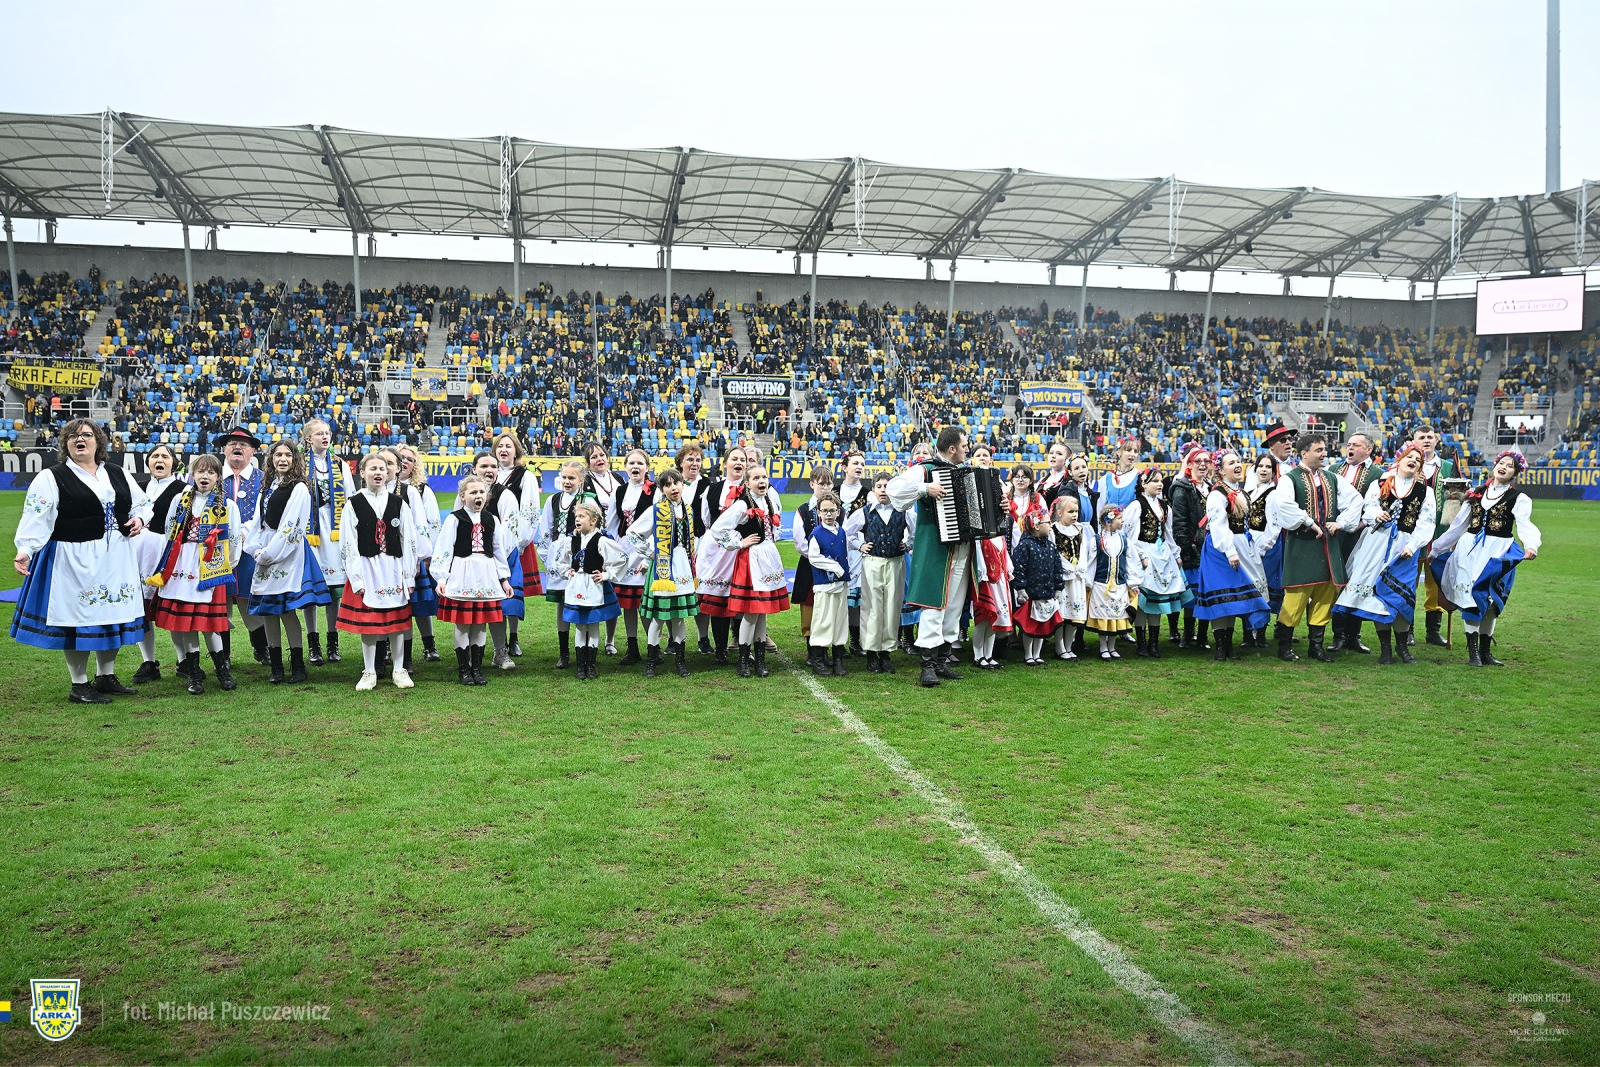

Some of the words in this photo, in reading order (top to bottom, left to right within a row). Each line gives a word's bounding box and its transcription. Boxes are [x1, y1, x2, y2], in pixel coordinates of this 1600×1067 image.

[33, 359, 44, 367] PO
[72, 372, 96, 386] HEL
[33, 384, 44, 393] PO
[393, 381, 401, 390] G
[450, 382, 461, 391] 15
[727, 380, 786, 396] GNIEWINO
[1033, 391, 1071, 404] MOSTY
[1337, 402, 1345, 410] 18
[656, 500, 671, 554] ARKA
